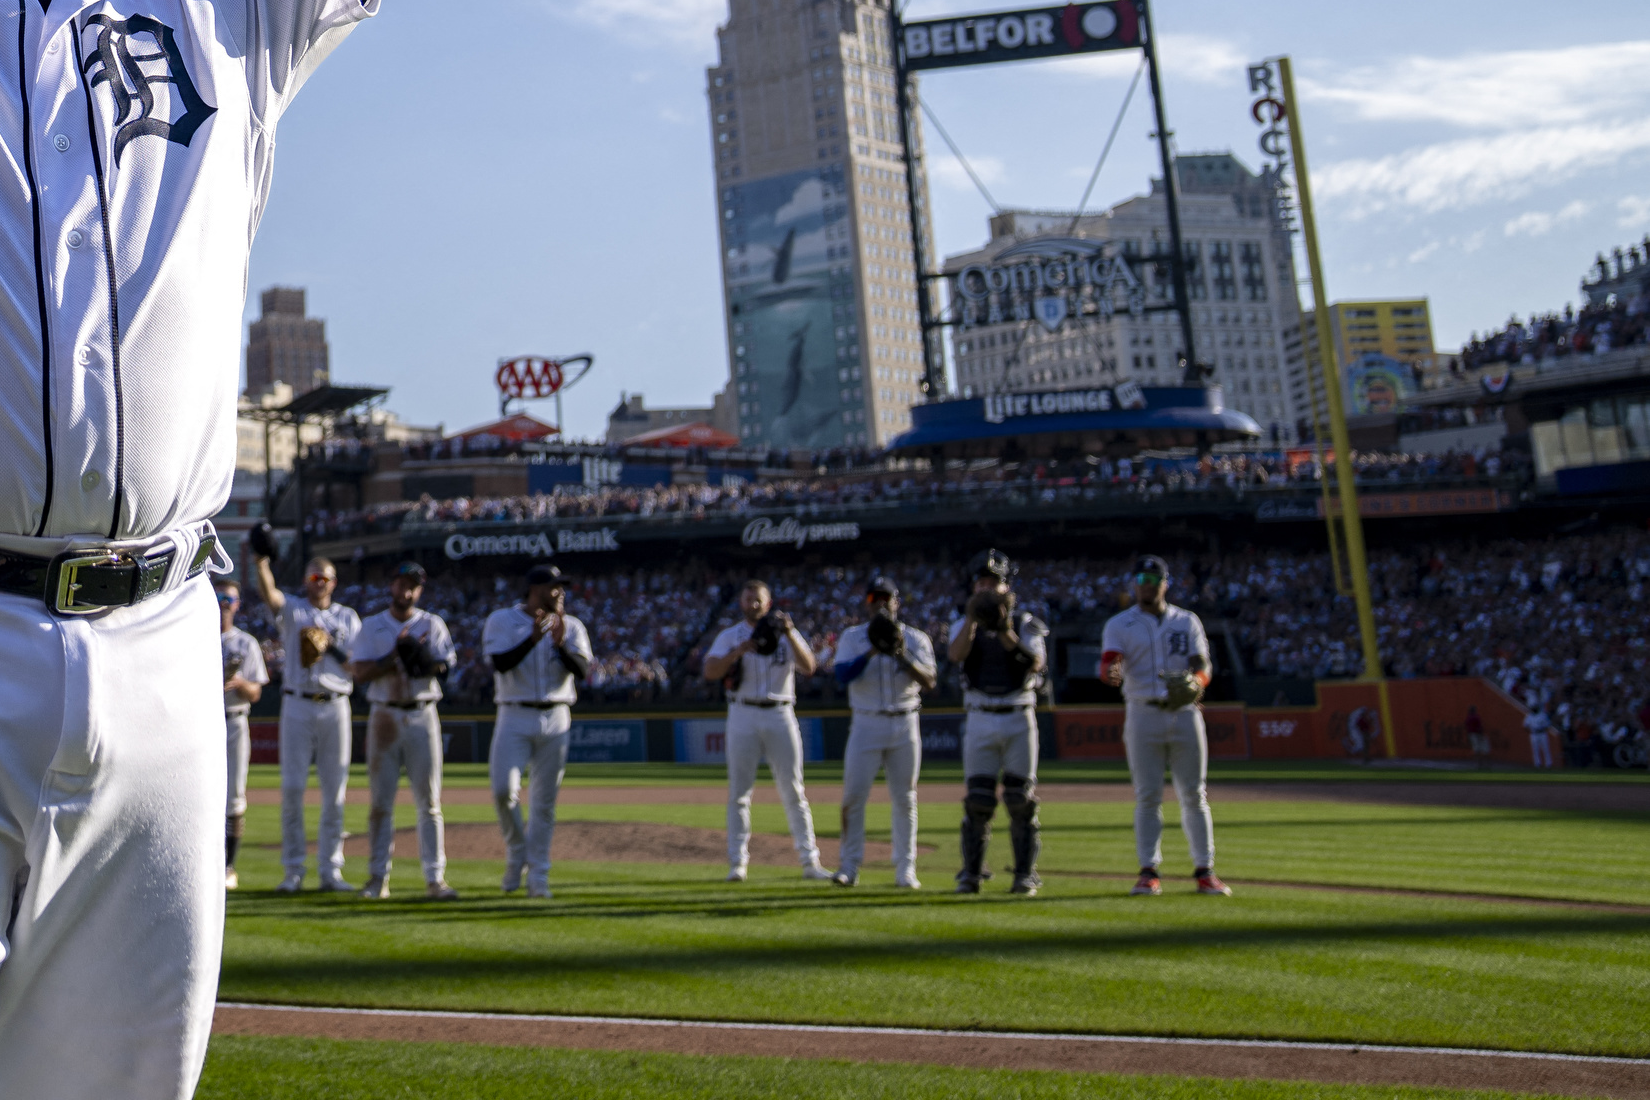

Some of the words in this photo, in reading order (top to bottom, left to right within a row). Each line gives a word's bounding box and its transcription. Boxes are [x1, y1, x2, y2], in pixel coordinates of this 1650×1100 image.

[904, 12, 1055, 59] BELFOR
[81, 13, 218, 168] D
[500, 358, 561, 398] AAA
[1030, 390, 1112, 415] LOUNGE
[557, 527, 620, 553] Bank
